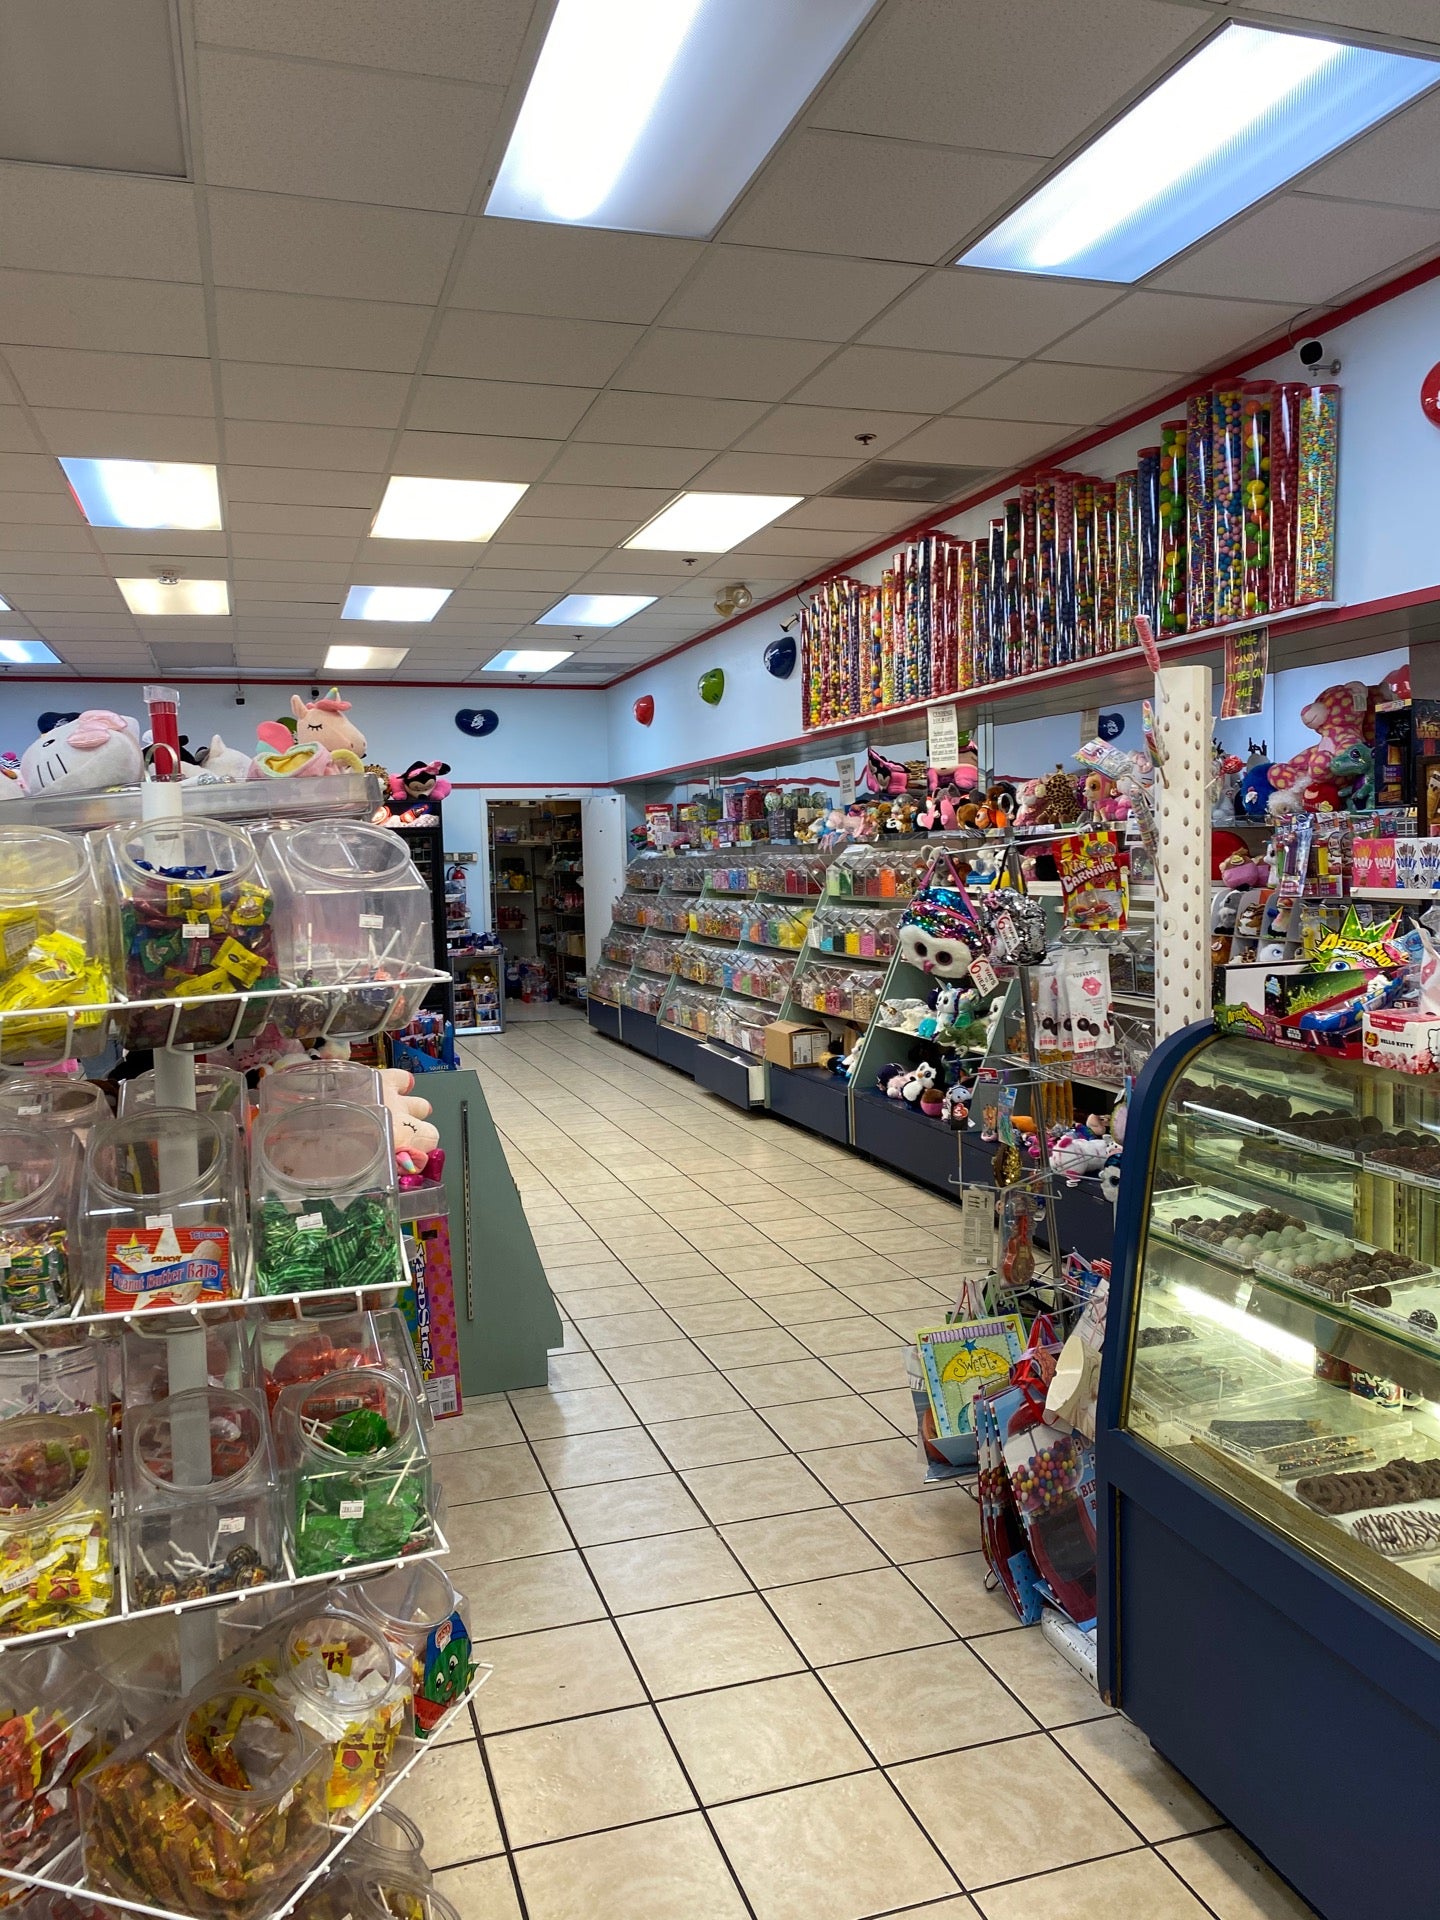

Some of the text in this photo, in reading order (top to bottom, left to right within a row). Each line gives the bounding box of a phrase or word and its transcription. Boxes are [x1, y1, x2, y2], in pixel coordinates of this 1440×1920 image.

[1235, 634, 1258, 648] LARGE
[1234, 652, 1260, 664] CANDY
[1228, 667, 1264, 682] TUBES ON
[1235, 686, 1254, 698] SALE
[1353, 820, 1375, 831] PEZ
[1062, 861, 1118, 893] CARNIVAL
[998, 916, 1011, 930] 6
[1319, 932, 1398, 967] AFTERSHO
[970, 960, 988, 974] 6
[975, 973, 988, 995] WEAR
[1380, 1038, 1414, 1049] HELLO KITTY
[151, 1255, 182, 1263] CRUNCHY
[113, 1262, 218, 1291] Peanut Butter Bars
